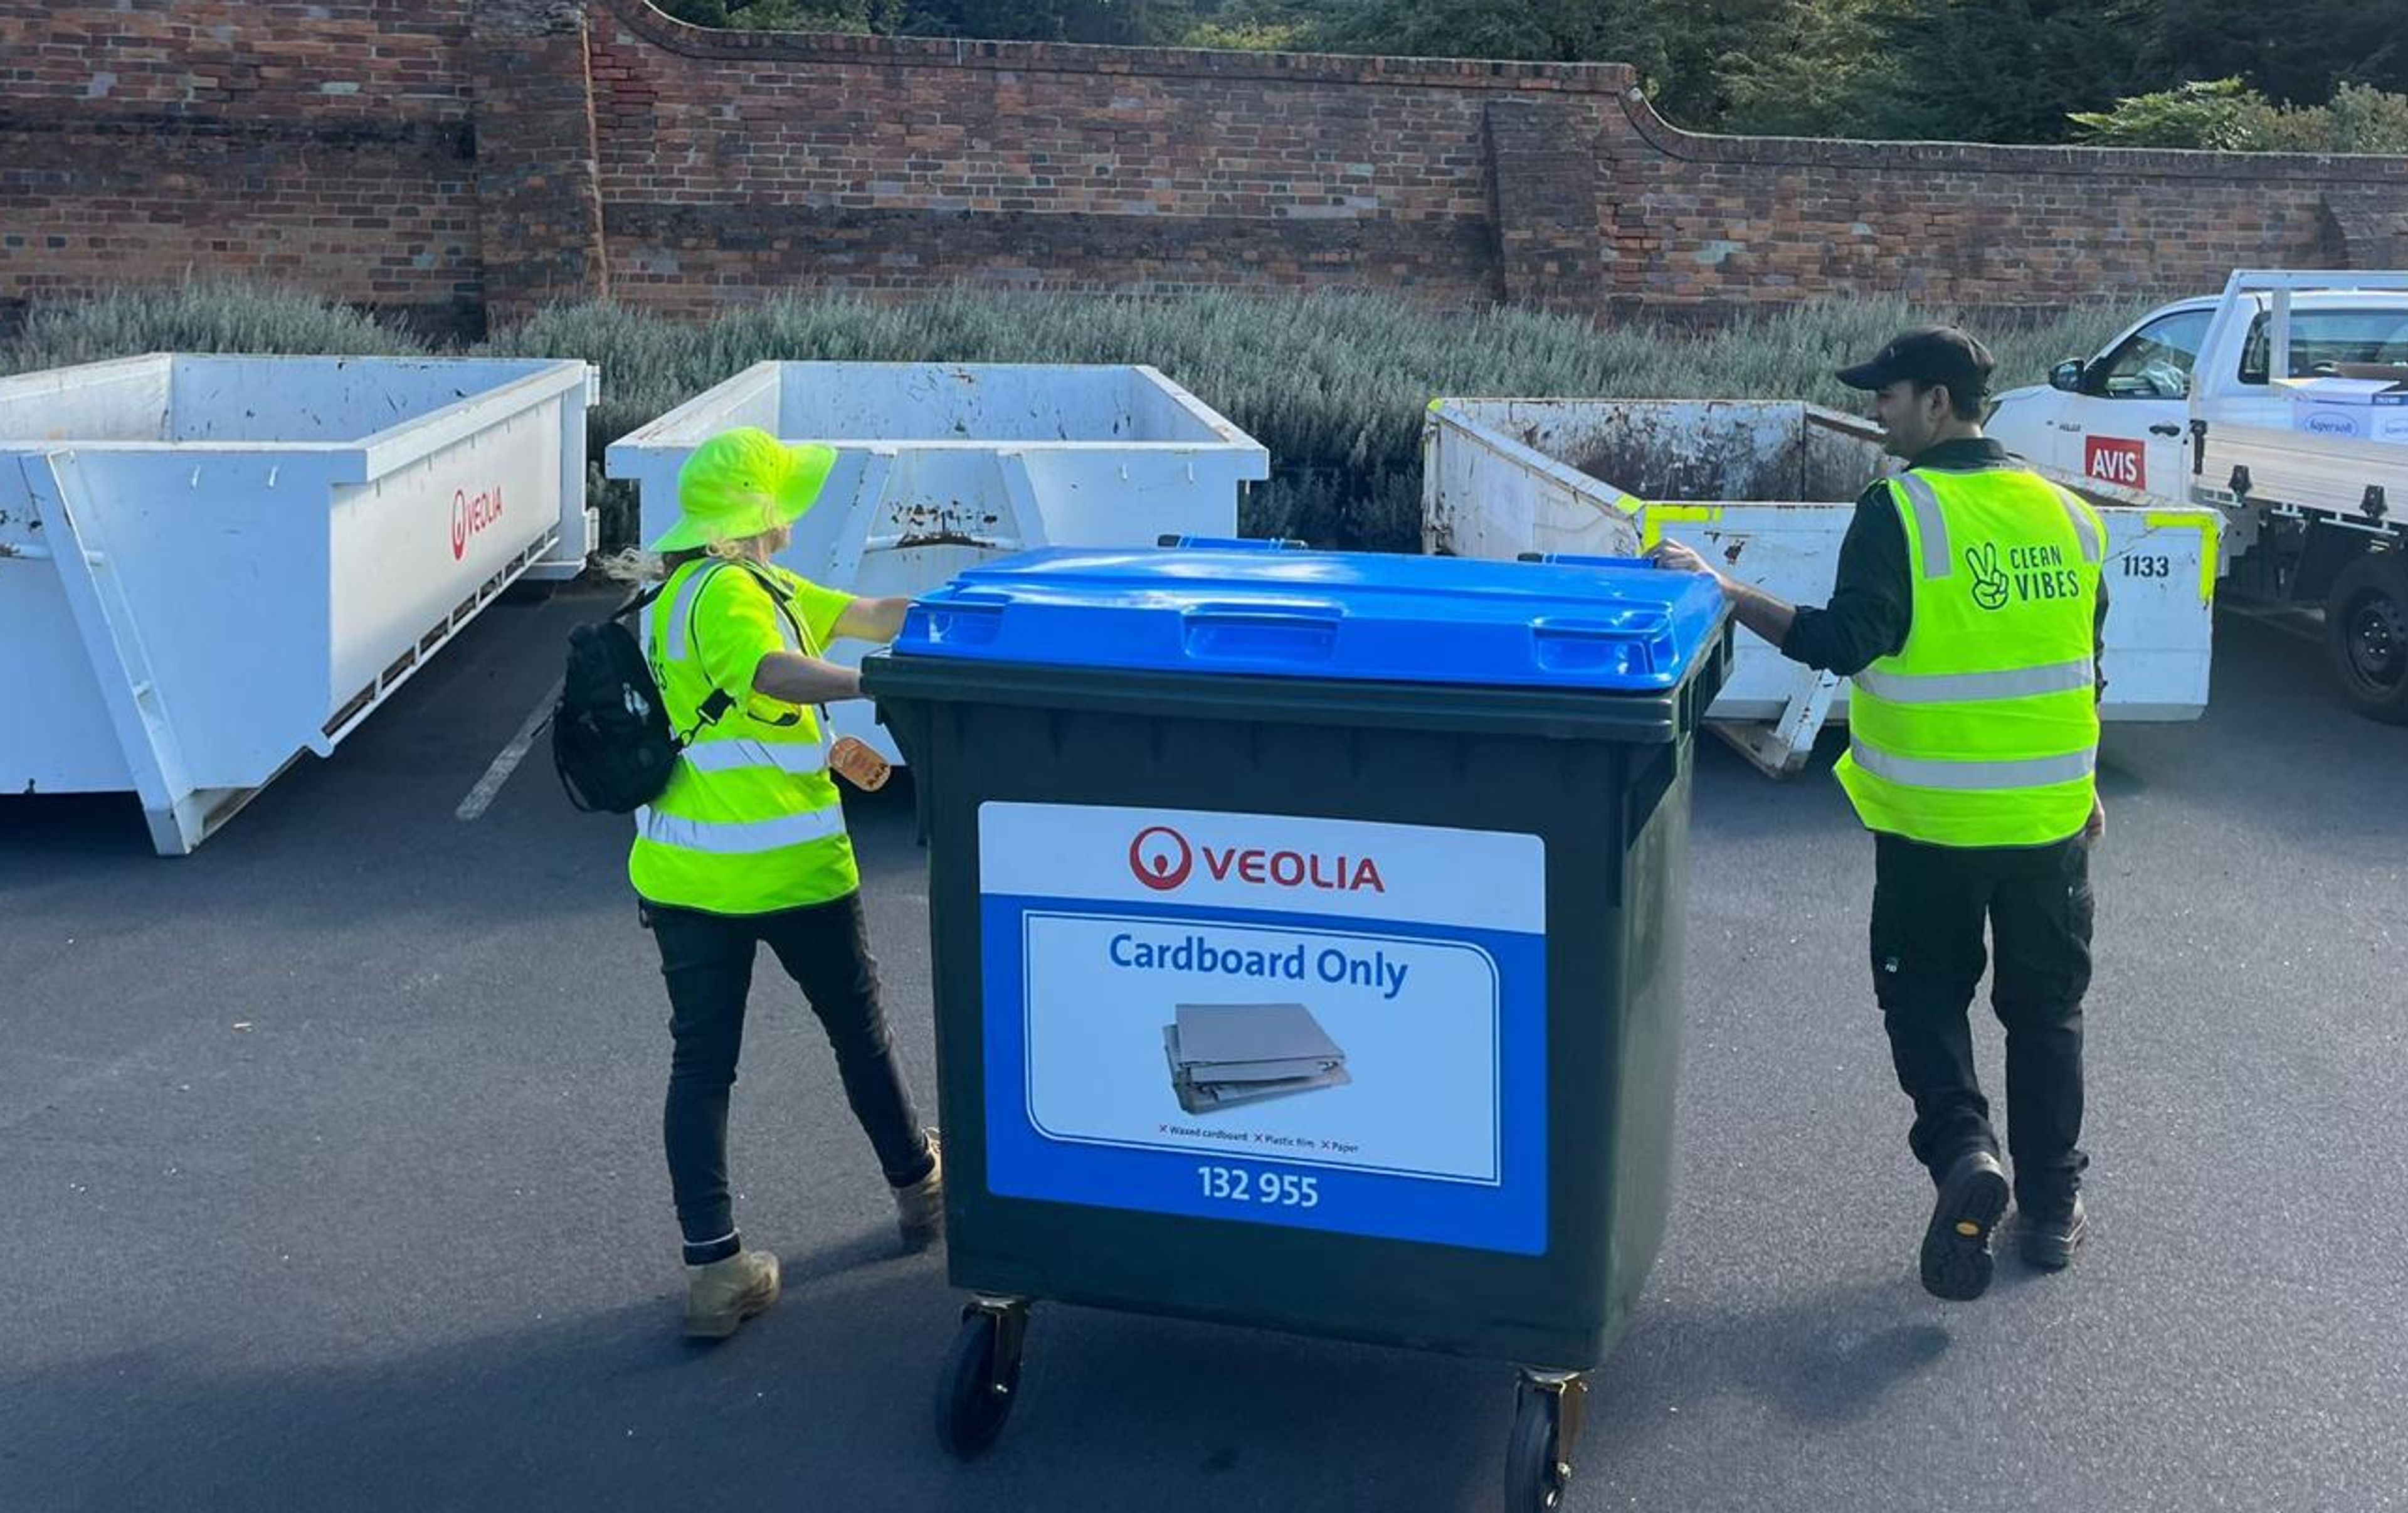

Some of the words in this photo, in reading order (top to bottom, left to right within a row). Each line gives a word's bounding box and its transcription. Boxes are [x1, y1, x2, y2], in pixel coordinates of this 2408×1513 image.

[2092, 448, 2137, 482] AVIS
[468, 486, 502, 535] VEOLIA
[2010, 545, 2062, 569] CLEAN
[2123, 555, 2169, 577] 1133
[2014, 570, 2079, 601] VIBES
[1202, 846, 1385, 893] VEOLIA
[1109, 934, 1305, 980] Cardboard
[1317, 948, 1408, 999] Only
[1170, 1127, 1201, 1137] Waxed
[1202, 1129, 1248, 1141] cardboard
[1265, 1135, 1294, 1146] Plastic
[1296, 1137, 1315, 1148] film
[1332, 1142, 1359, 1153] Paper
[1198, 1166, 1250, 1201] 132
[1259, 1172, 1318, 1207] 955
